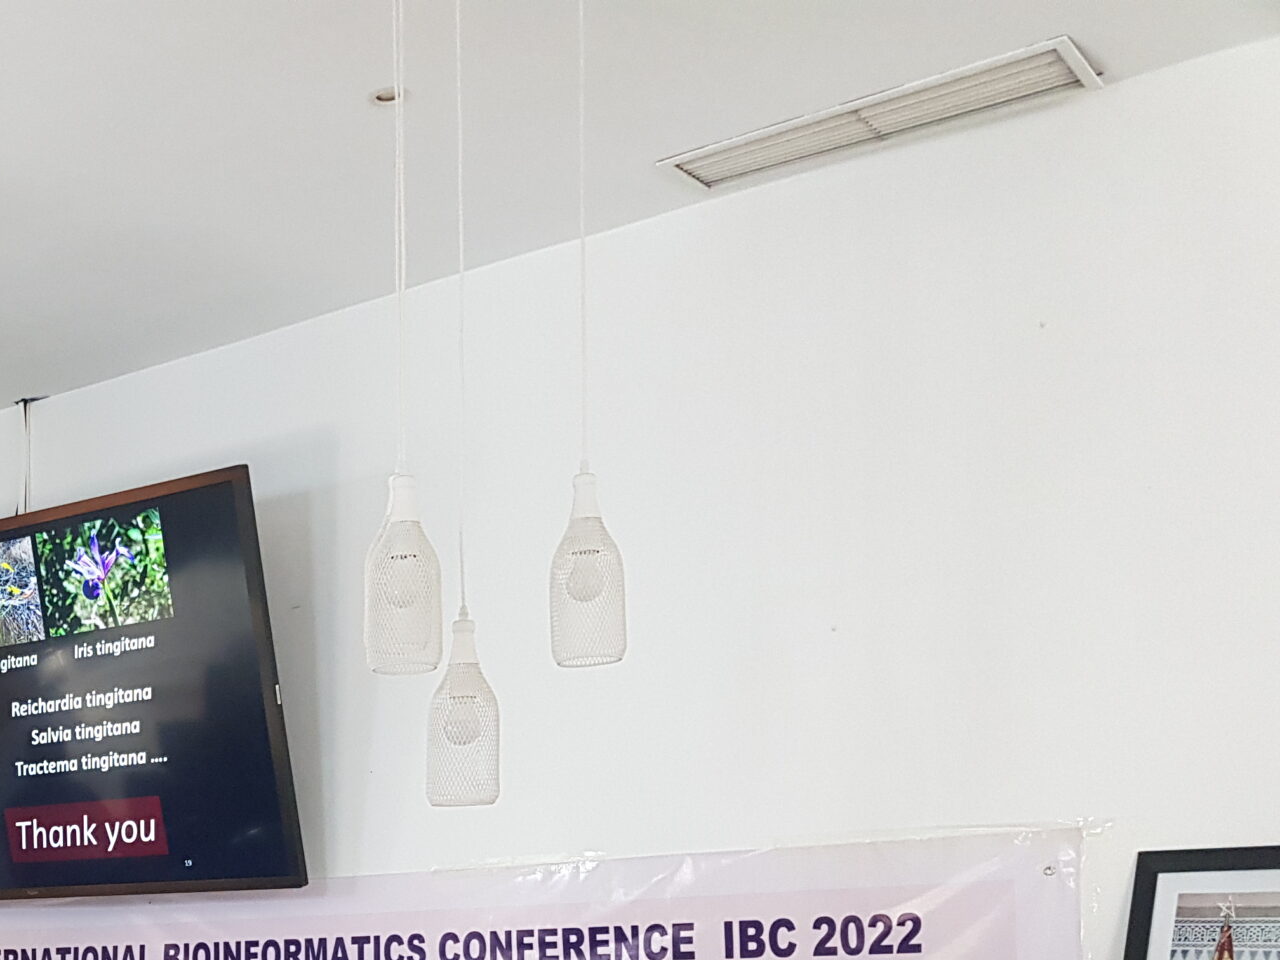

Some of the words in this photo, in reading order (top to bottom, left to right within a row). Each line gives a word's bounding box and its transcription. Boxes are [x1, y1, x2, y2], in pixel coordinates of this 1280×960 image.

[74, 642, 94, 659] Iris
[96, 634, 155, 657] tingitana
[11, 694, 83, 718] Reichardia
[85, 686, 152, 709] tingitana
[31, 726, 72, 746] Salvia
[74, 719, 140, 742] tingitana
[15, 758, 78, 777] Tractema
[81, 750, 146, 772] tingitana
[15, 815, 98, 850] Thank
[106, 818, 156, 853] you
[724, 918, 797, 959] IBC
[812, 913, 922, 957] 2022
